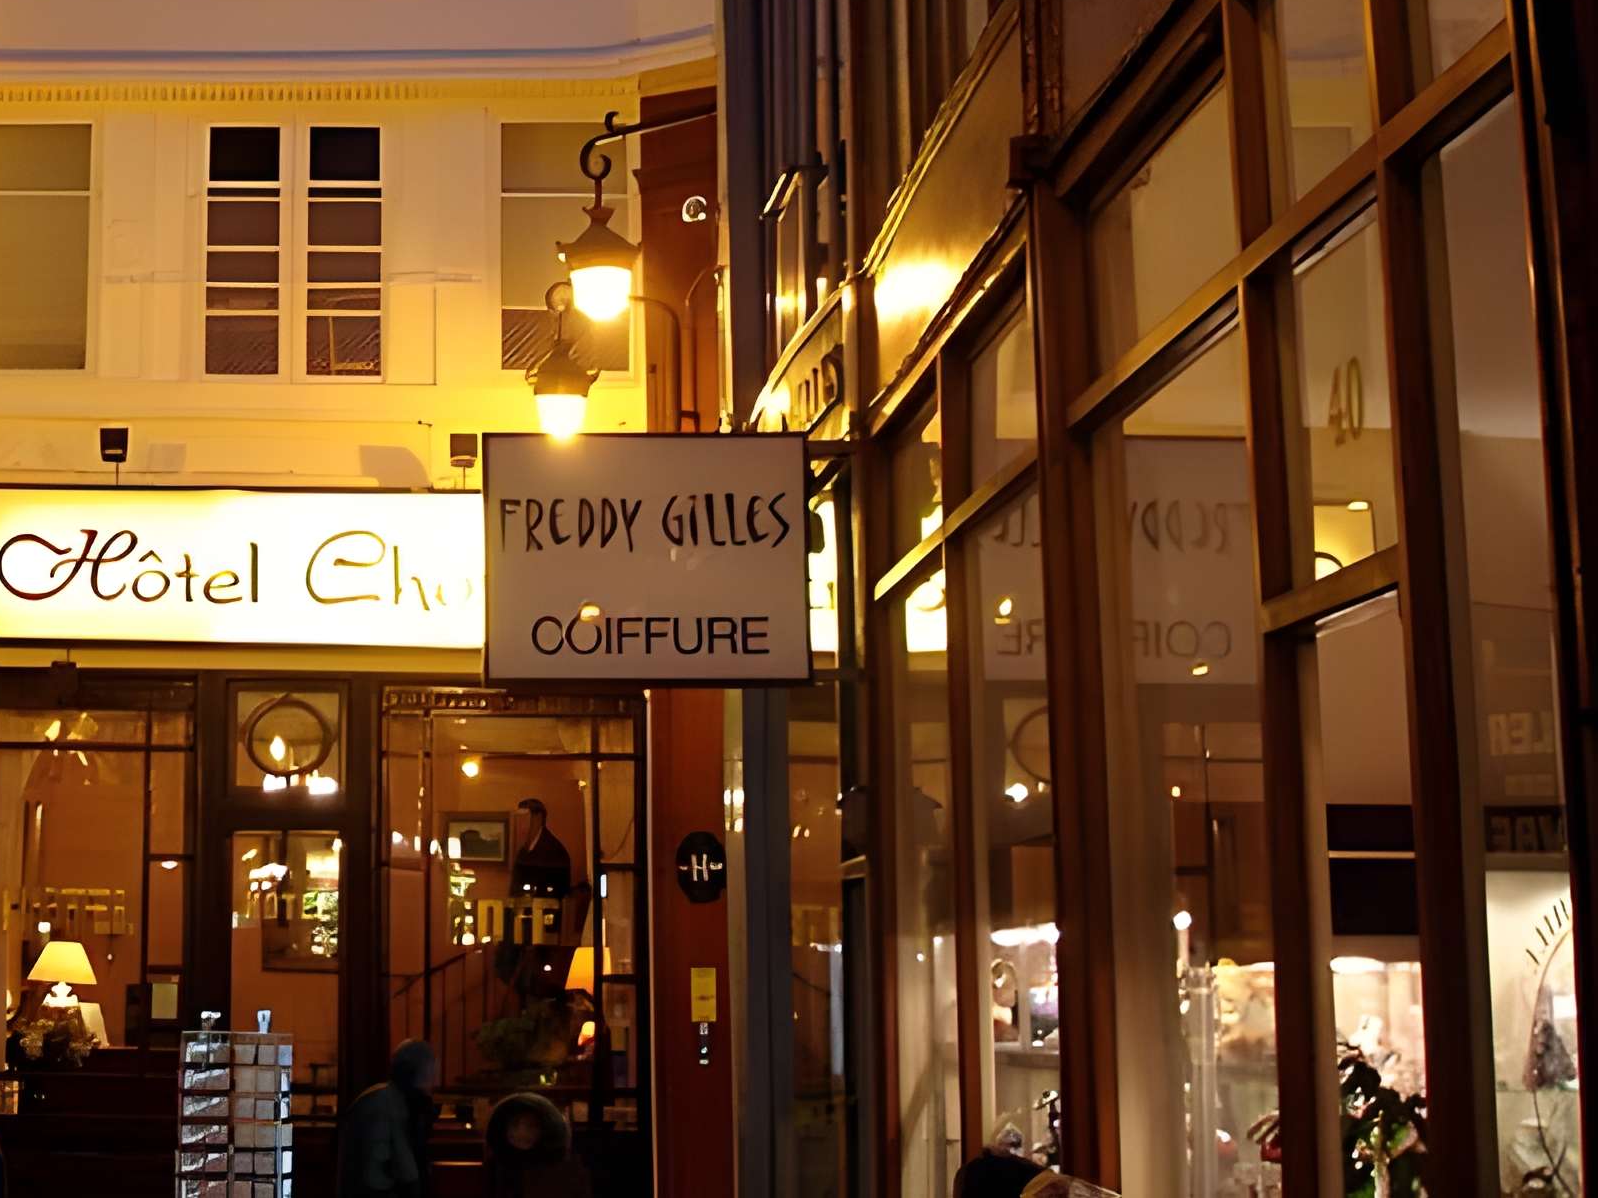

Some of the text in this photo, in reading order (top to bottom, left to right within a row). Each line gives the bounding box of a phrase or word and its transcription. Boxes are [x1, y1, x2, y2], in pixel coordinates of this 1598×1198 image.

[500, 492, 790, 553] FREDDY GILLES
[531, 614, 770, 655] COIFFURE
